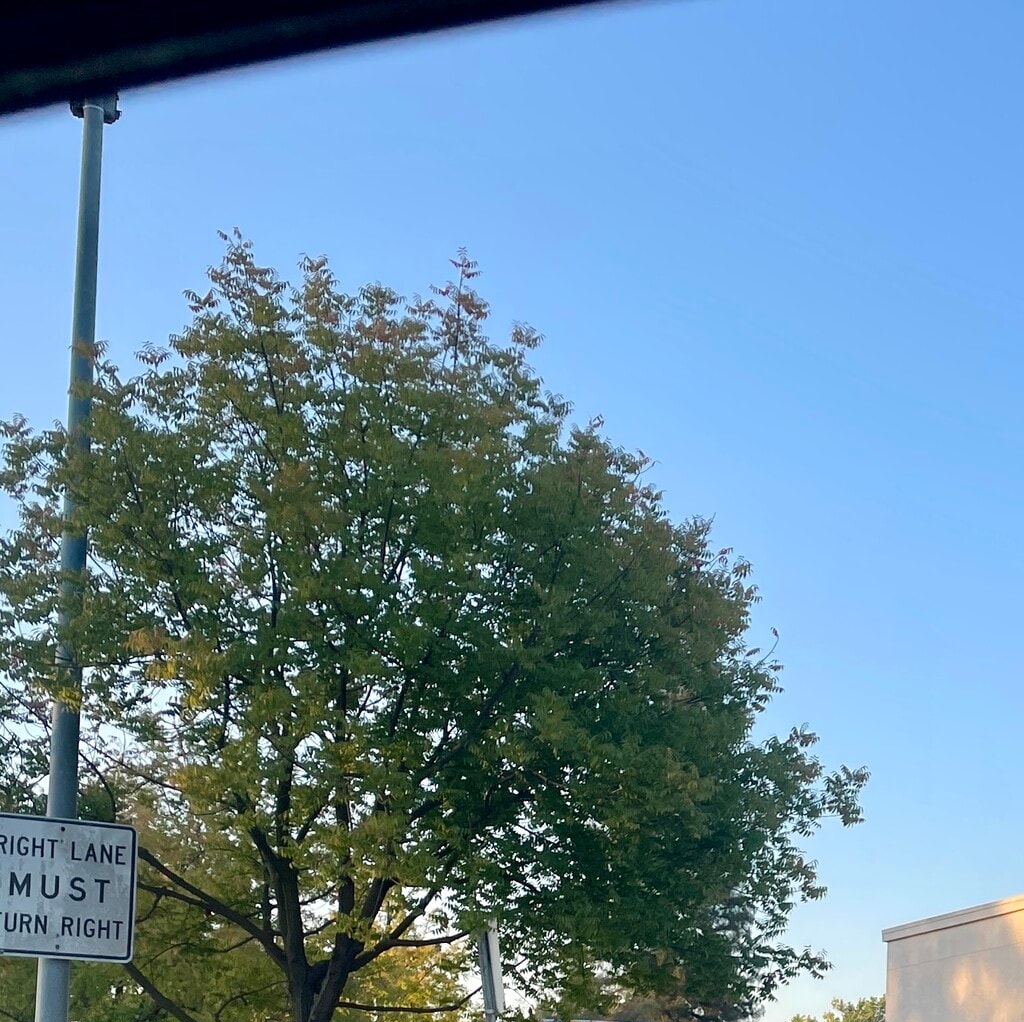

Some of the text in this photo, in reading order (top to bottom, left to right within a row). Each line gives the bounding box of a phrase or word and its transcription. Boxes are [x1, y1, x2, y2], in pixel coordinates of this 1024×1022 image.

[0, 834, 126, 865] RIGHT LANE
[9, 871, 111, 903] MUST
[0, 912, 124, 940] URN RIGHT
